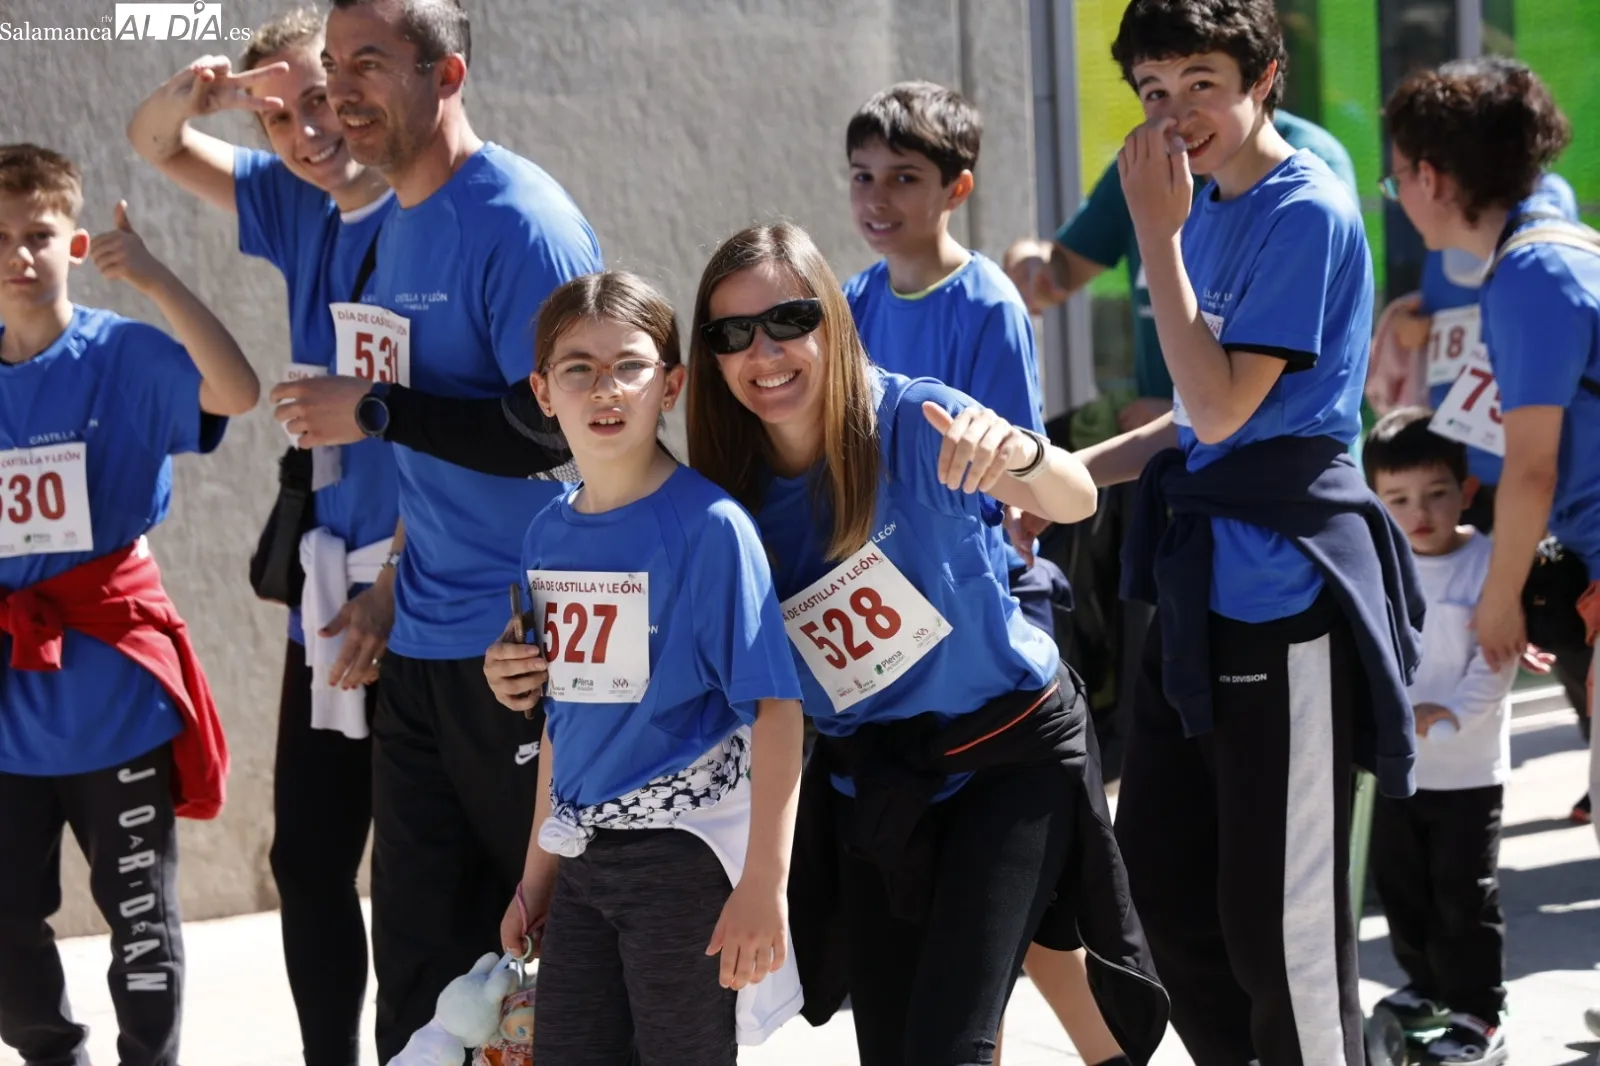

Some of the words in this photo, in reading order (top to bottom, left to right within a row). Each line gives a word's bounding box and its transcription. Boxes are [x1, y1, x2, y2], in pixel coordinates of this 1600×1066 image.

[421, 293, 428, 304] Y
[337, 310, 356, 321] DÍA
[357, 312, 369, 323] DE
[354, 332, 398, 384] 531
[29, 430, 77, 445] CASTILLA
[52, 450, 81, 464] LEÓN
[0, 471, 66, 525] 30
[872, 521, 897, 543] LEÓN
[532, 578, 545, 591] DÍA
[545, 581, 554, 591] DE
[555, 581, 597, 593] CASTILLA
[599, 583, 605, 594] Y
[606, 580, 642, 594] LEÓN
[788, 606, 801, 620] DE
[798, 583, 841, 613] CASTILLA
[837, 576, 847, 586] Y
[846, 552, 879, 580] LEÓN
[543, 601, 618, 664] 527
[799, 586, 902, 670] 528
[880, 650, 903, 669] Plena
